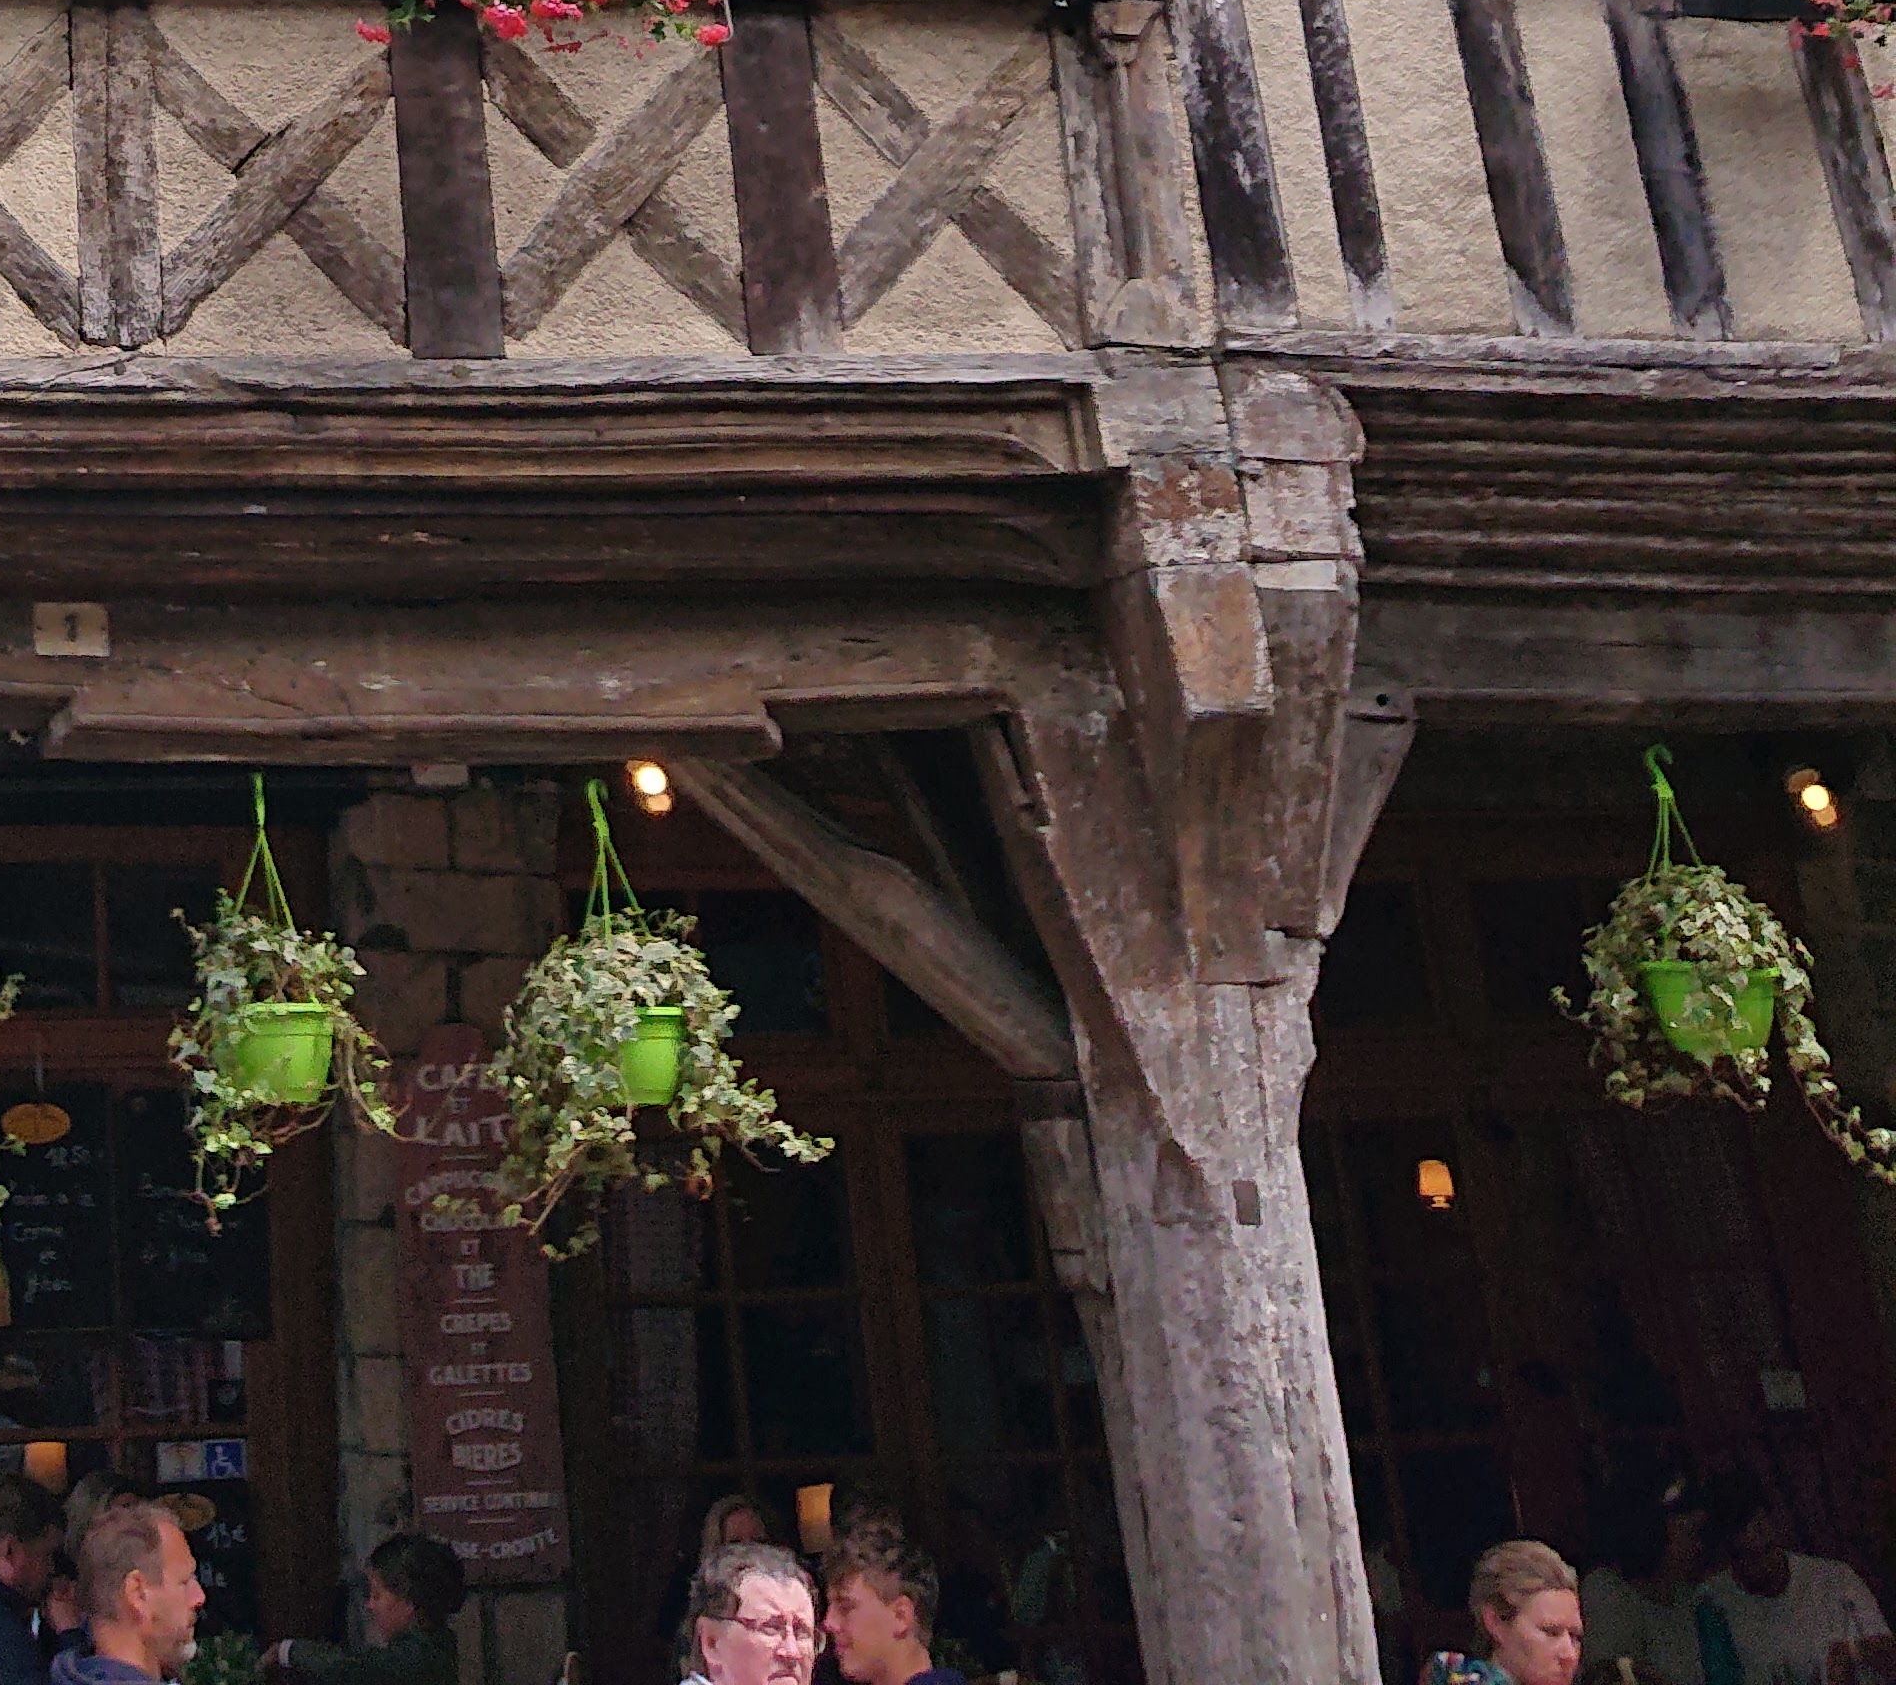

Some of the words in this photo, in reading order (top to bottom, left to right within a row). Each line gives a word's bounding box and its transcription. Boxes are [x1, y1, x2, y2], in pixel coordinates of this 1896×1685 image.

[430, 1362, 533, 1386] GALETTES
[446, 1407, 525, 1435] CIDRES
[451, 1442, 523, 1472] BIERES
